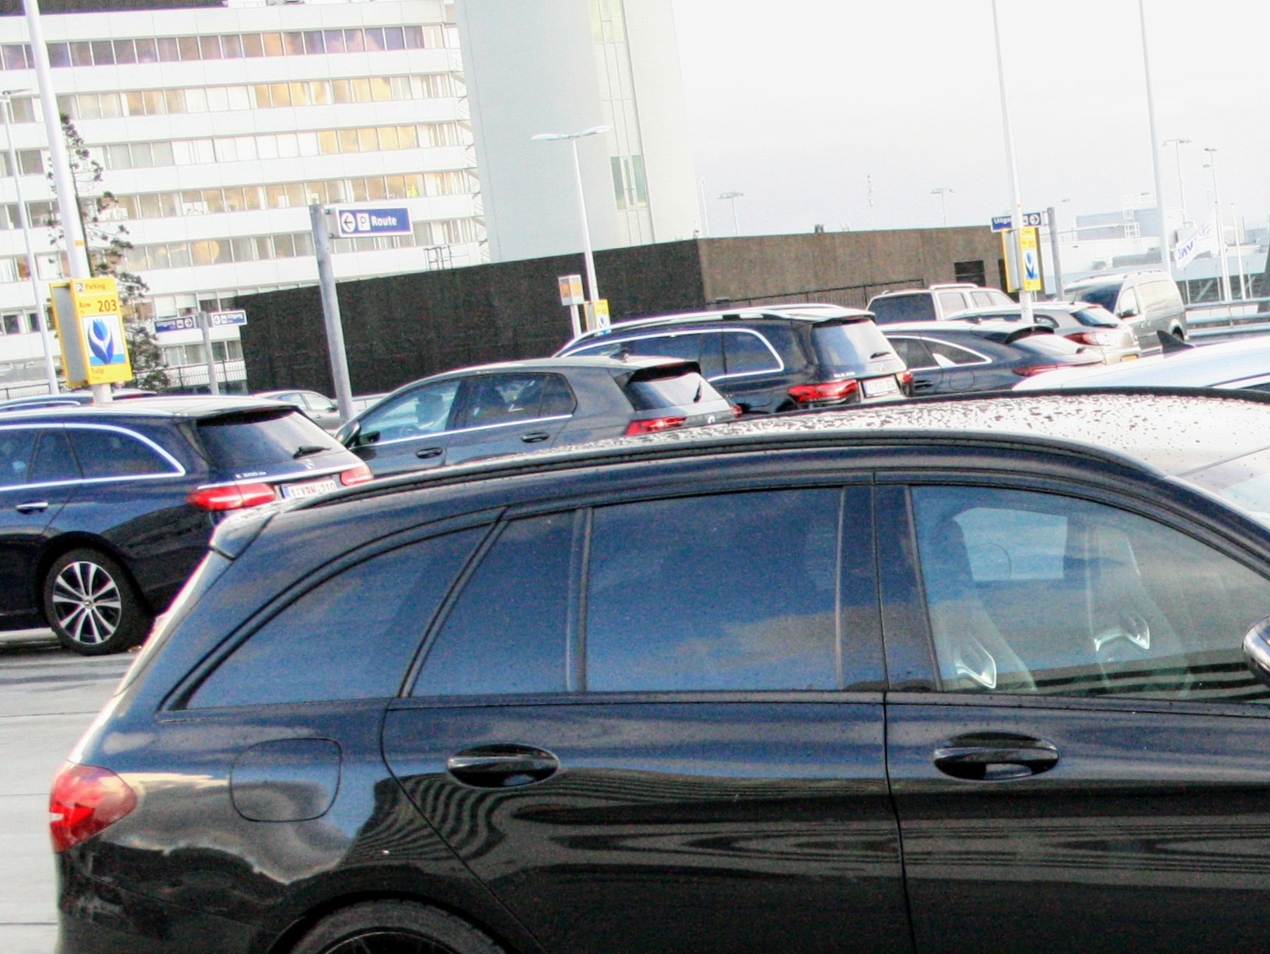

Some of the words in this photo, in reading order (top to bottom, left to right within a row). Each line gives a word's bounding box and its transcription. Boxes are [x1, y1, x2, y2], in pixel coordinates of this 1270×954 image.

[371, 216, 397, 226] Route
[85, 283, 106, 291] Parking
[97, 299, 118, 313] 203
